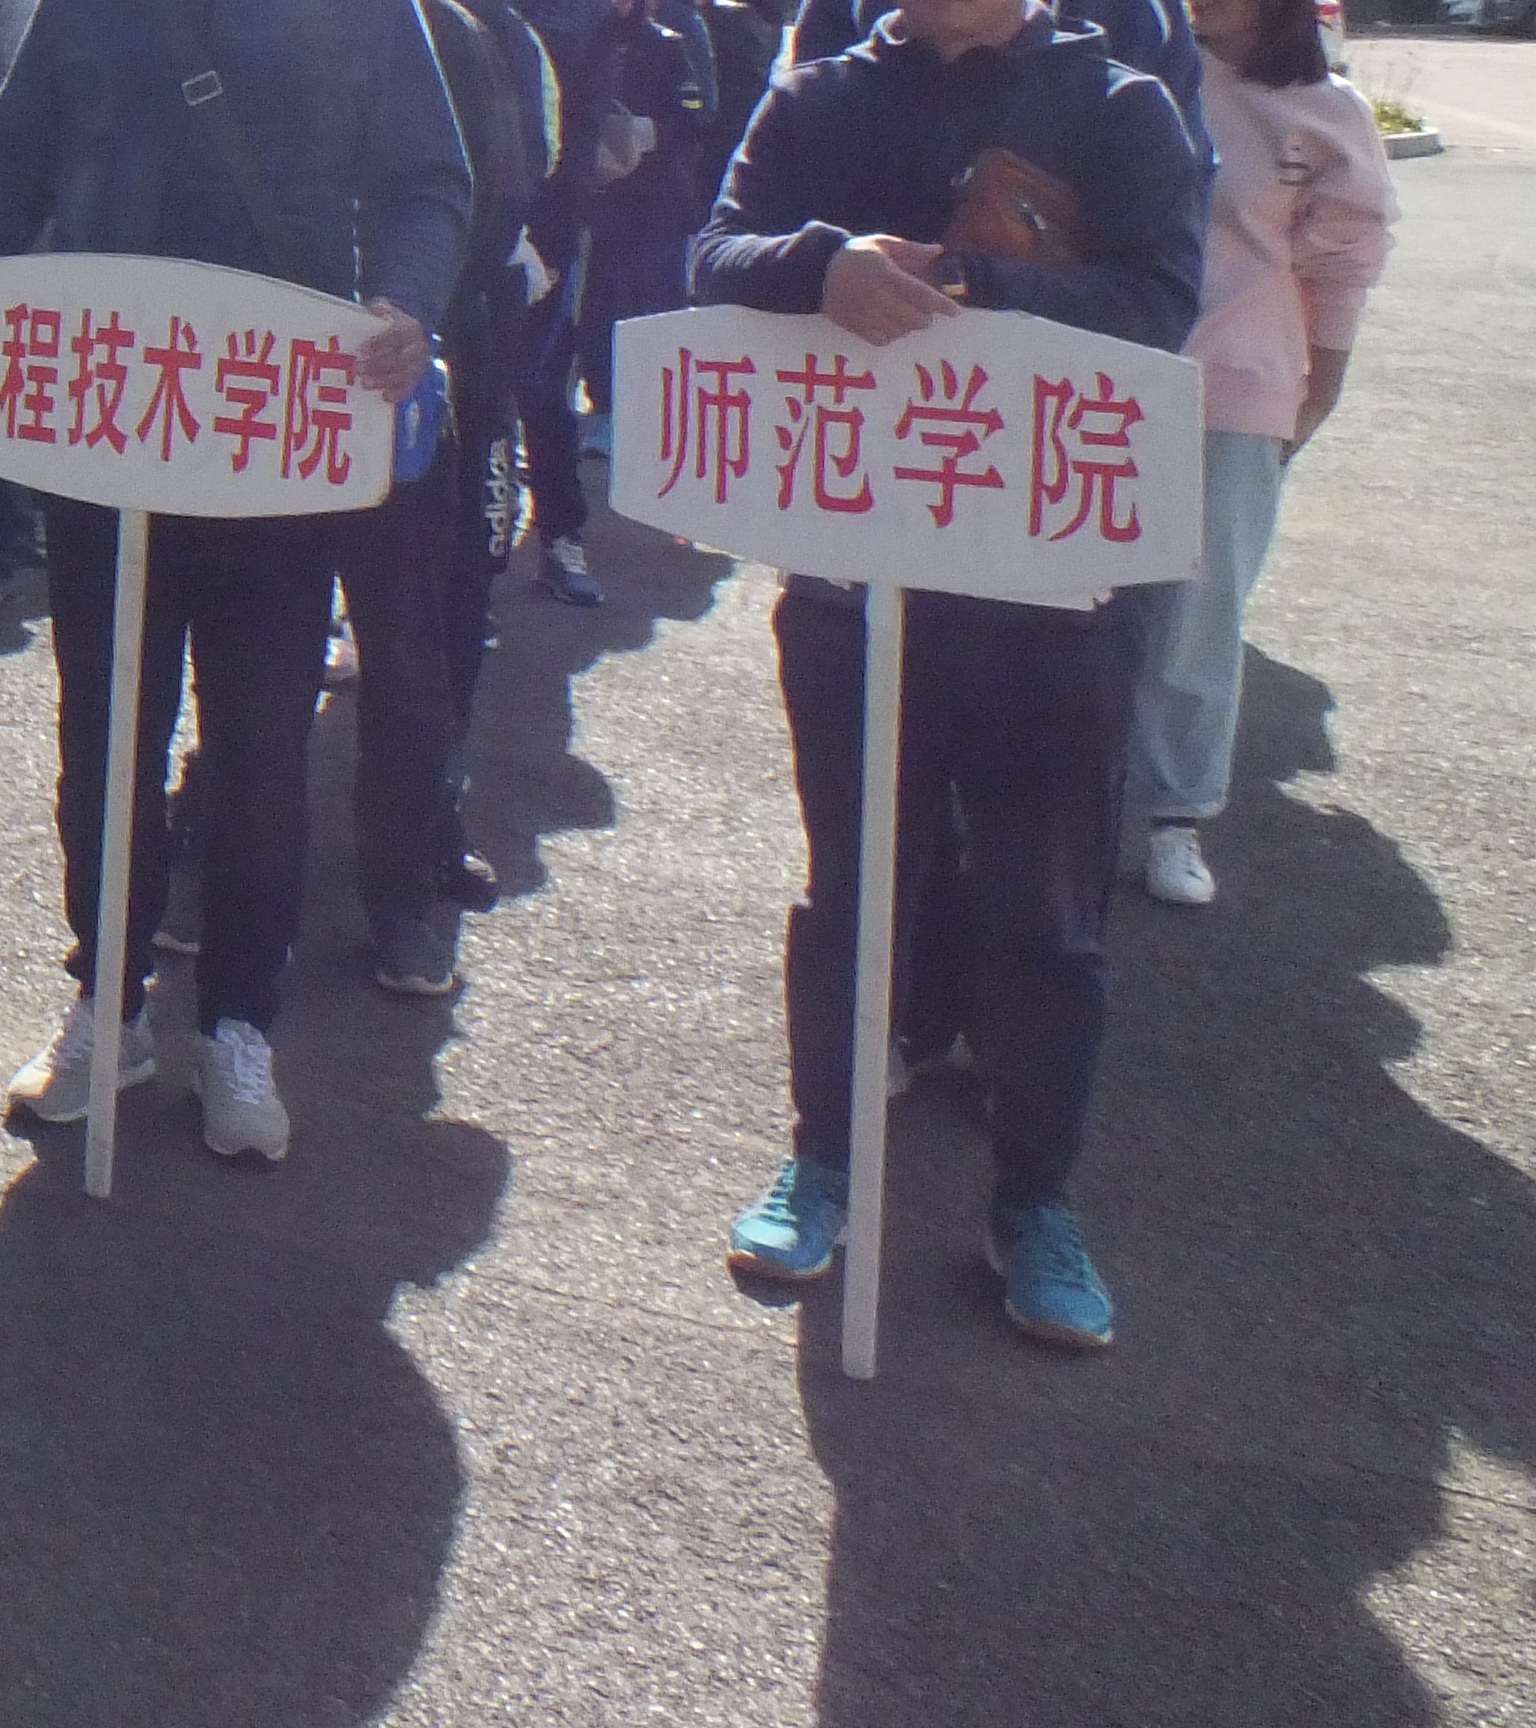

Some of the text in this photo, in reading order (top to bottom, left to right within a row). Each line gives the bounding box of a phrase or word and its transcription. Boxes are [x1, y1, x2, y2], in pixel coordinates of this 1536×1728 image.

[485, 437, 509, 558] adidas
[658, 346, 1145, 544] 师范学院
